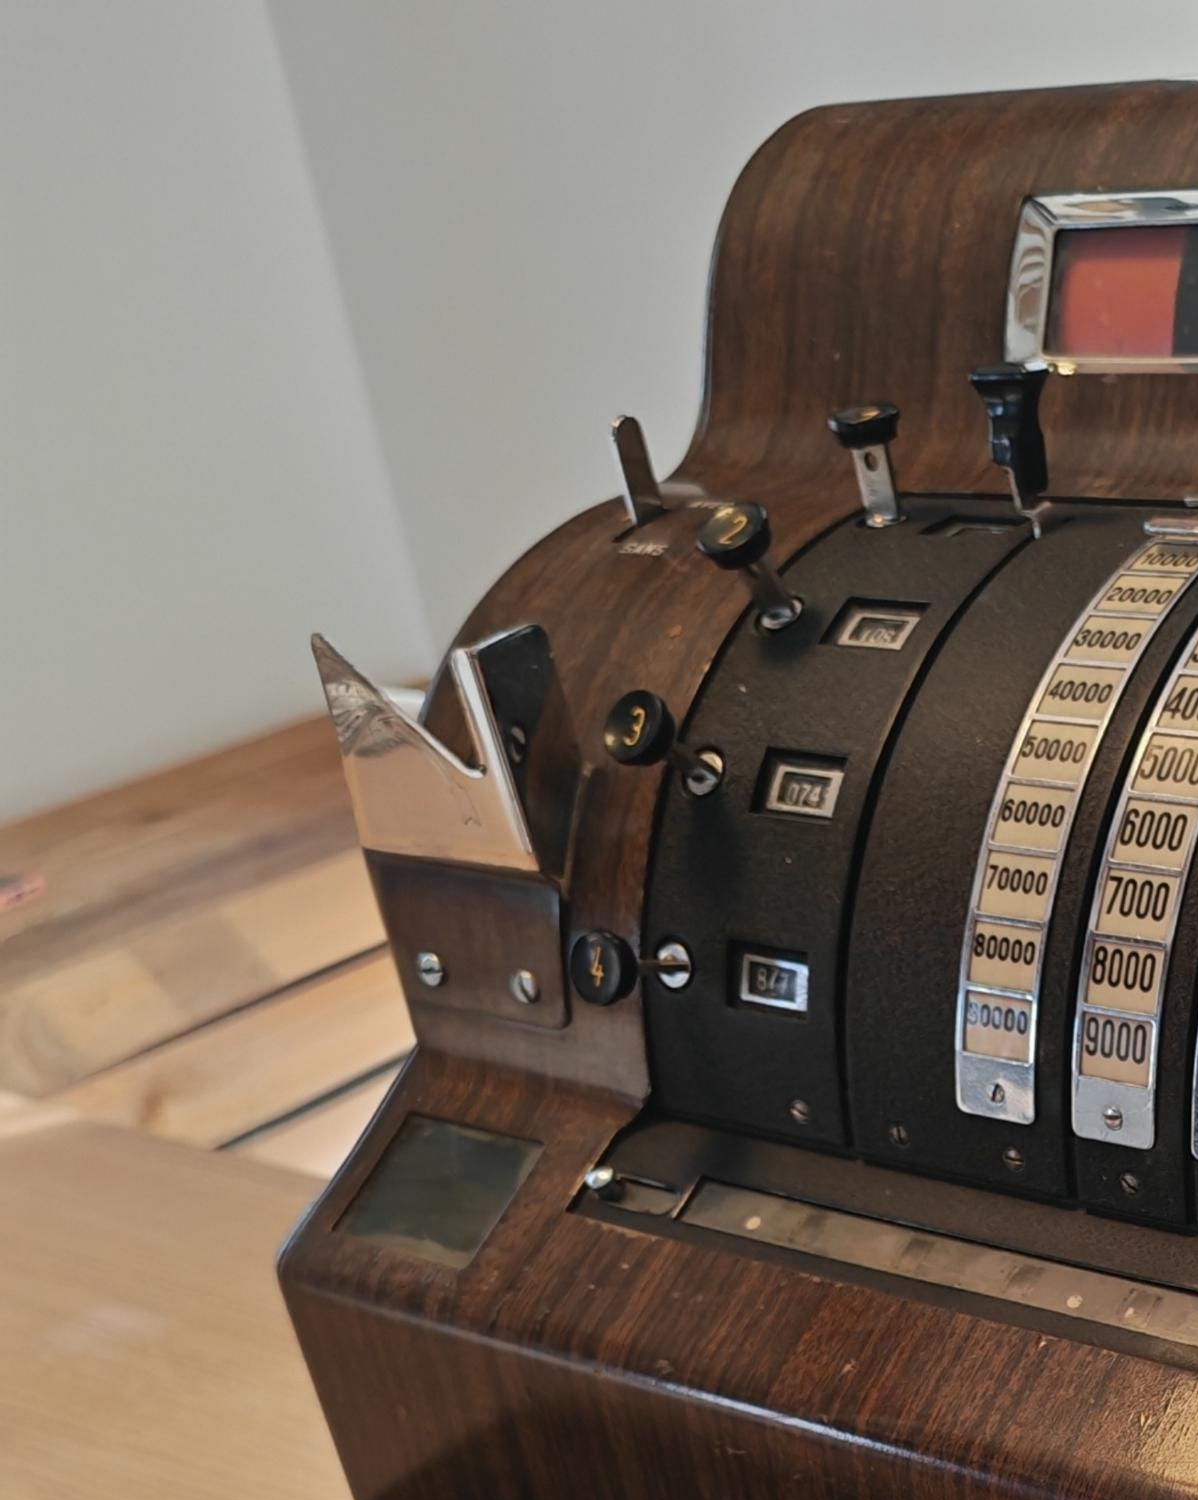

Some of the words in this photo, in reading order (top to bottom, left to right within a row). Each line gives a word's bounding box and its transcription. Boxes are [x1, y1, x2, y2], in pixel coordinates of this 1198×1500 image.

[719, 514, 748, 545] 2
[1106, 586, 1173, 604] 20000
[1074, 630, 1142, 651] 30000
[1049, 680, 1113, 703] 40000
[624, 706, 646, 746] 3
[1021, 736, 1087, 764] 50000
[1001, 799, 1065, 828] 60000
[1120, 809, 1188, 851] 6000
[985, 865, 1048, 896] 70000
[1105, 876, 1170, 921] 7000
[974, 933, 1036, 965] 80000
[590, 946, 605, 987] 4
[1092, 946, 1156, 992] 8000
[1085, 1017, 1147, 1064] 9000
